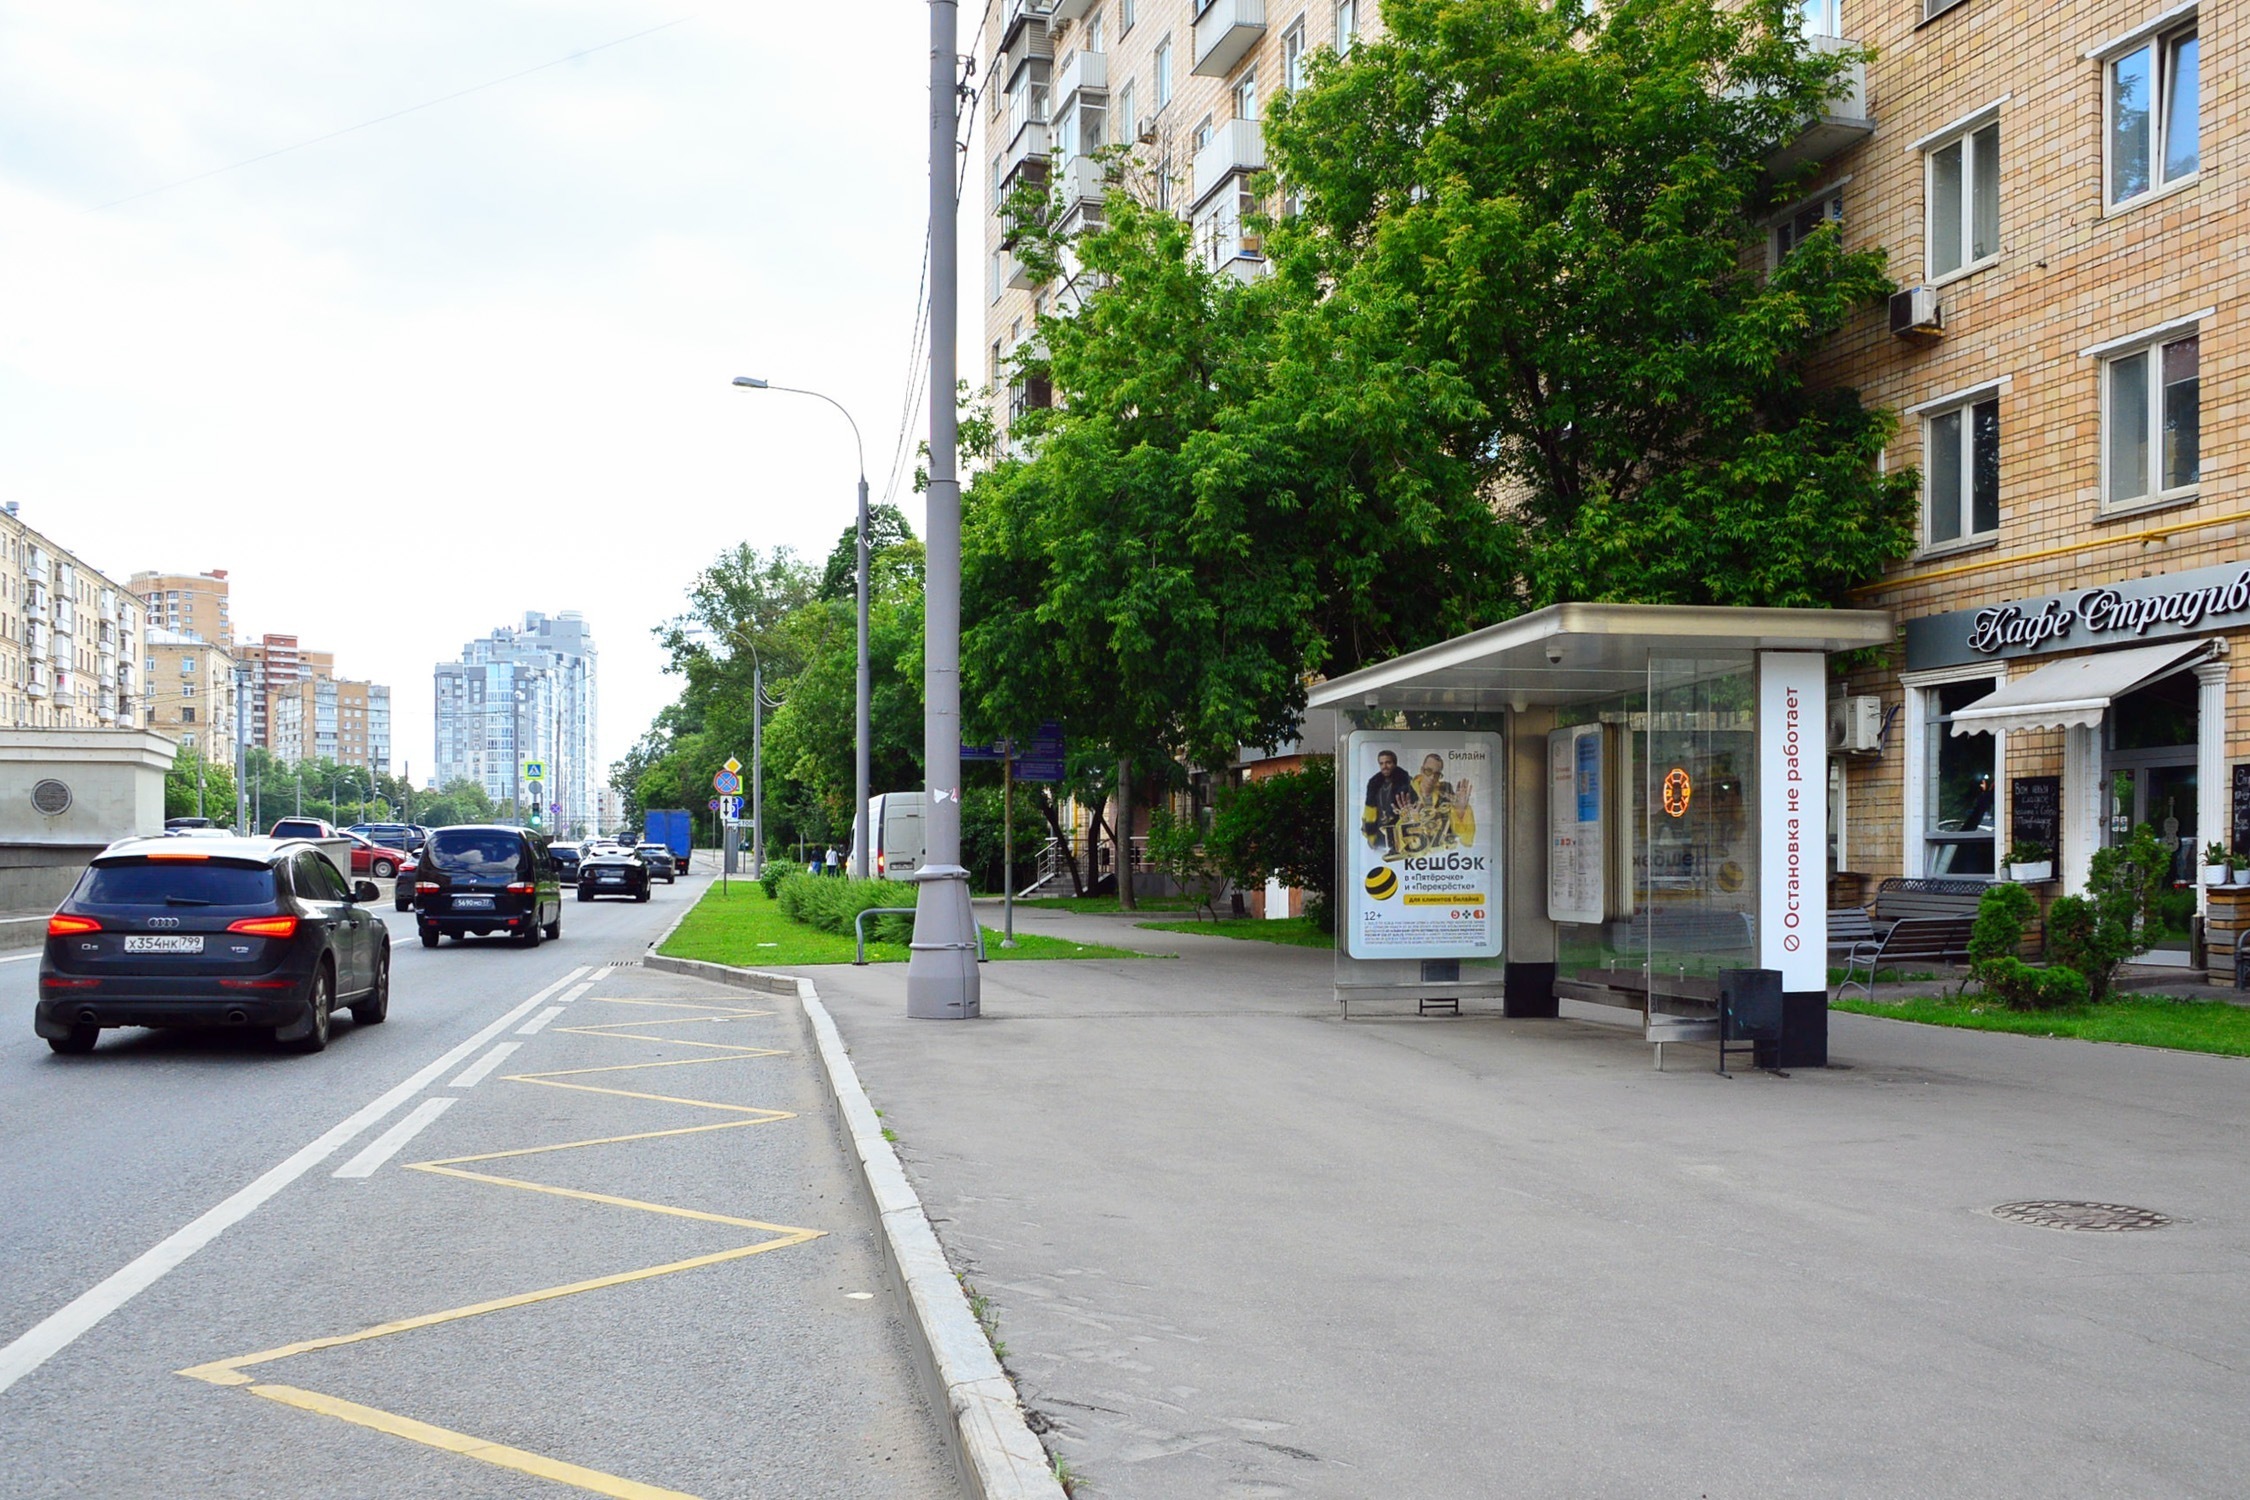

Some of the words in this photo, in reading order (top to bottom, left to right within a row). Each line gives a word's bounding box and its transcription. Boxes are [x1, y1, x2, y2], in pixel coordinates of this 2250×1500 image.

[1967, 599, 2071, 653] Кафе
[2076, 568, 2250, 634] Страдив
[1782, 686, 1803, 781] работает
[1448, 750, 1486, 761] билайн
[1788, 788, 1799, 811] не
[1380, 819, 1458, 861] 15%
[1404, 852, 1485, 871] кешбэк
[1411, 873, 1464, 882] «Пятёрочке»
[1784, 819, 1799, 928] Остановка
[1412, 882, 1475, 891] «Перекрёстке»
[1364, 911, 1382, 921] 12+
[181, 937, 201, 947] 799
